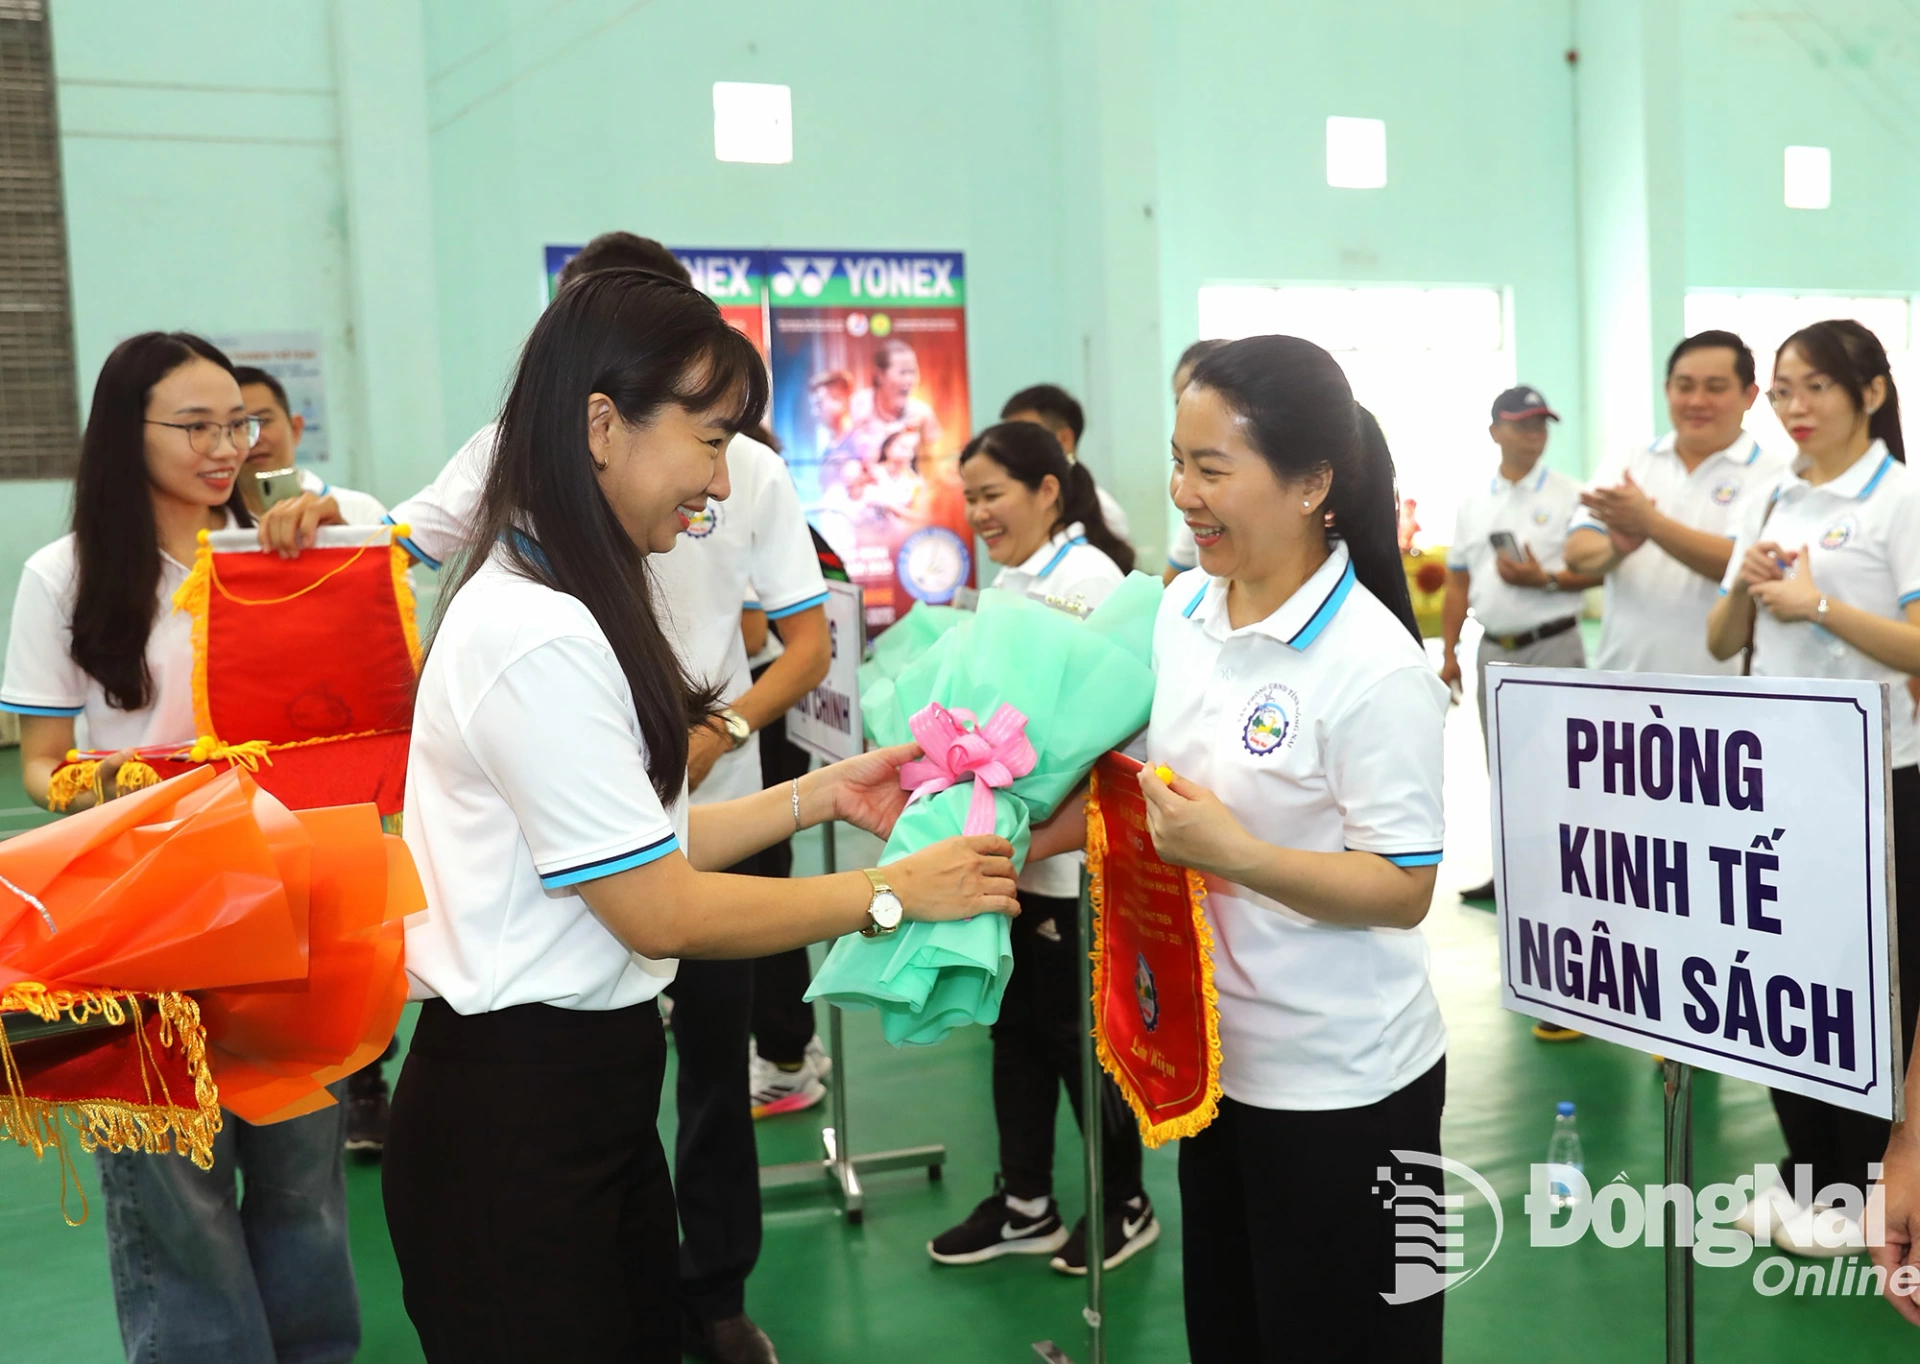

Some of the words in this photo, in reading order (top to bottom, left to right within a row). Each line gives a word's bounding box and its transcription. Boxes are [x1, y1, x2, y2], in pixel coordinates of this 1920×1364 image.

[685, 257, 752, 297] NEX
[842, 257, 955, 298] YONEX
[1566, 704, 1764, 812] PHÒNG
[1559, 823, 1690, 917] KINH
[1708, 828, 1786, 935] TẾ
[1518, 917, 1661, 1021] NGÂN
[1681, 949, 1856, 1072] SÁCH
